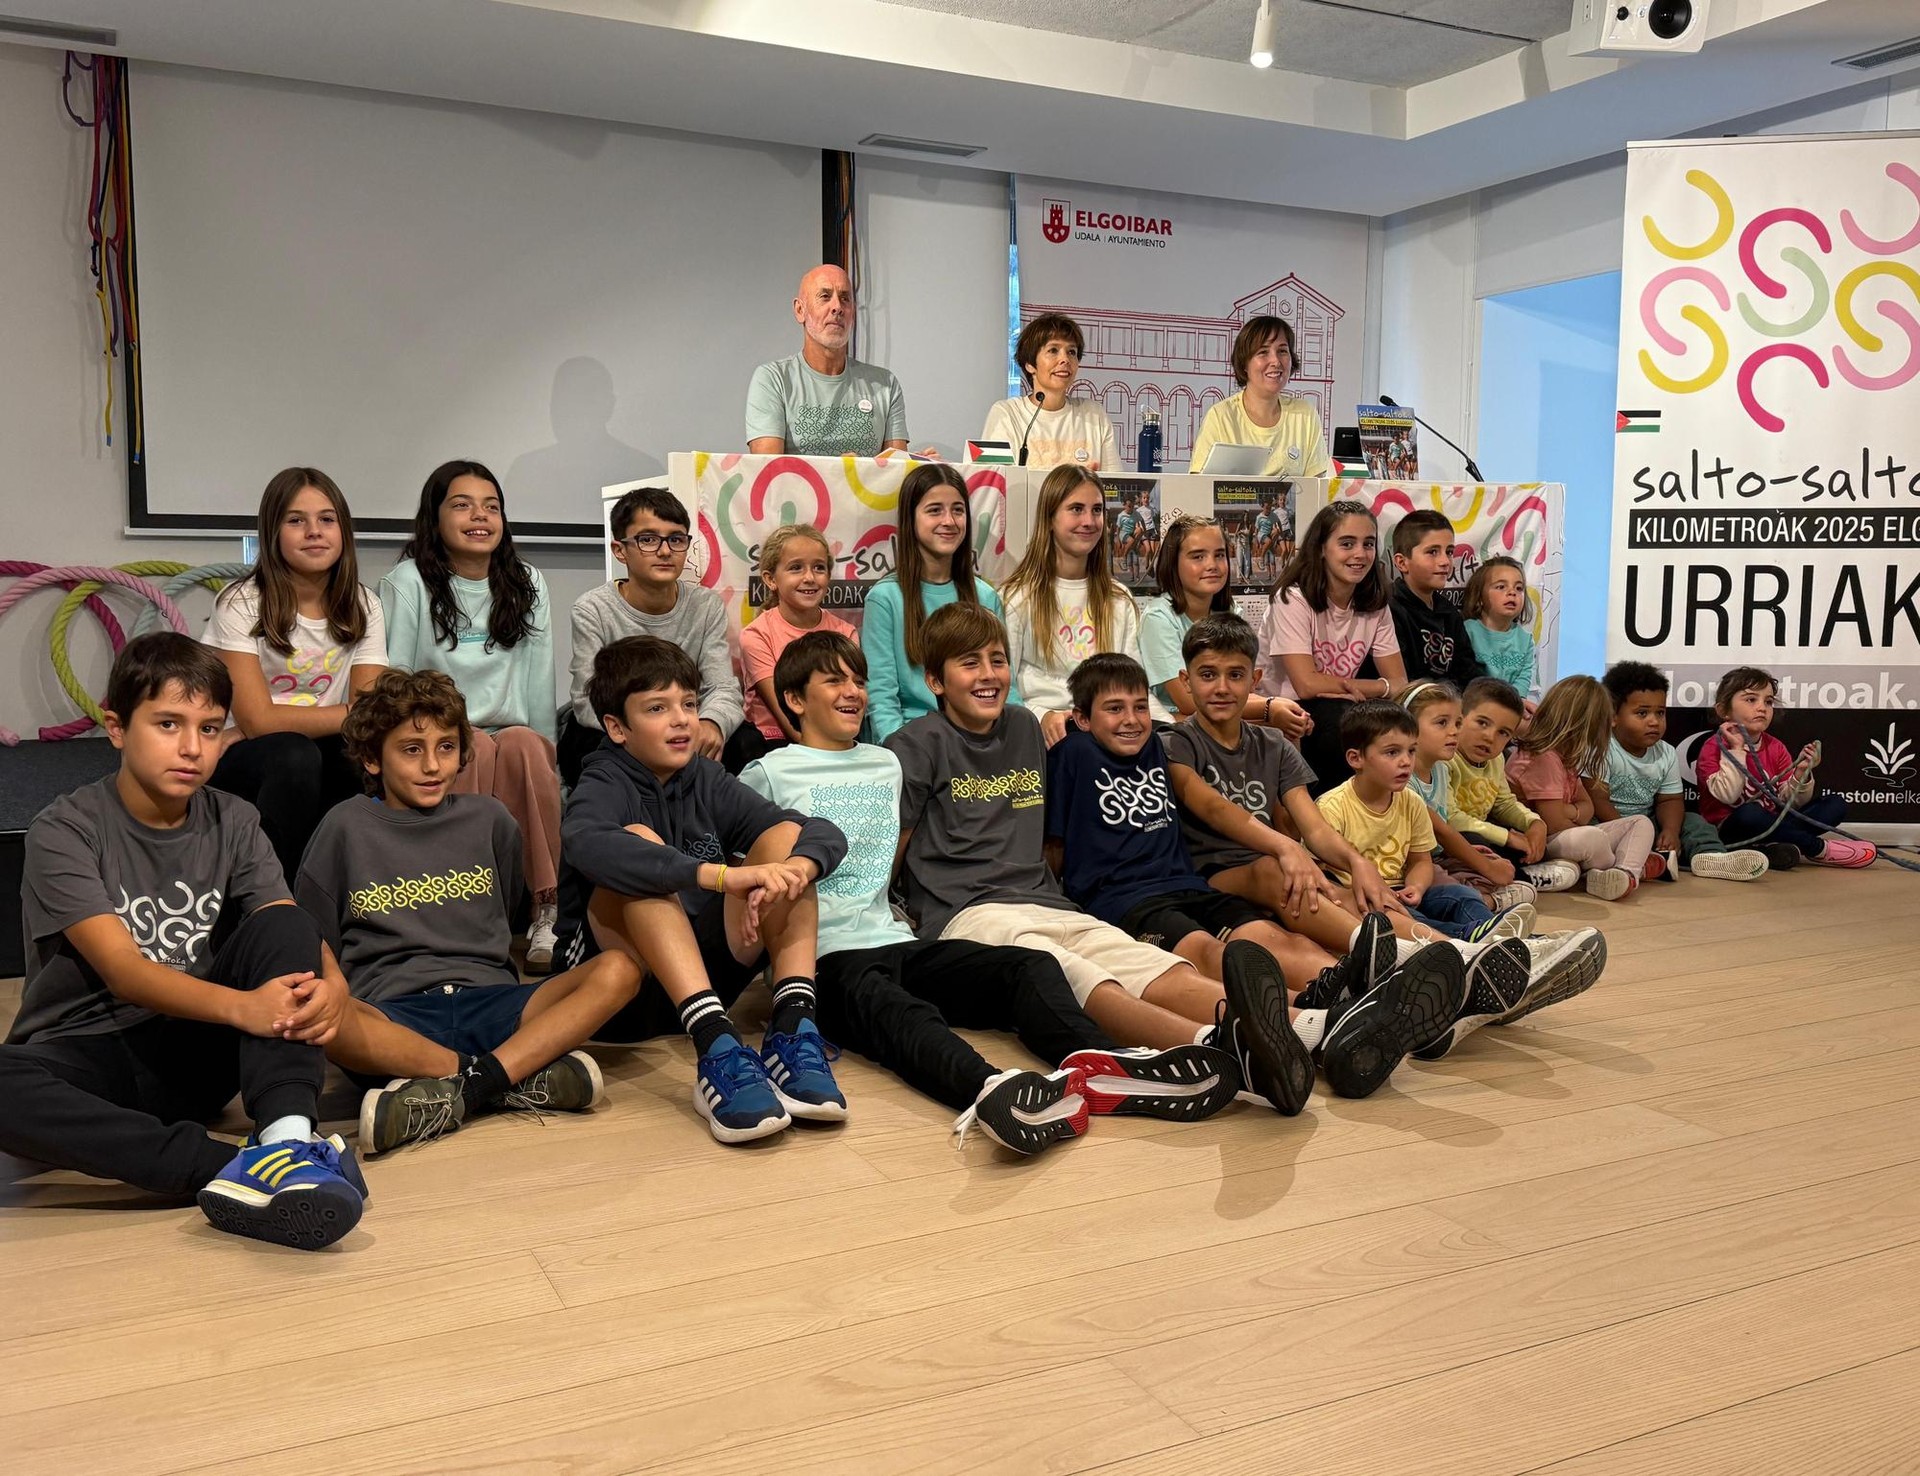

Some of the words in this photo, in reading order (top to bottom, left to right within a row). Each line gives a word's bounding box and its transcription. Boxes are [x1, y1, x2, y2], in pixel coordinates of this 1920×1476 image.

[1075, 210, 1173, 236] ELGOIBAR
[1074, 232, 1100, 242] UDALA
[1108, 235, 1166, 248] AYUNTAMIENTO
[1813, 516, 1874, 542] 2025
[1624, 565, 1920, 647] URRIAK
